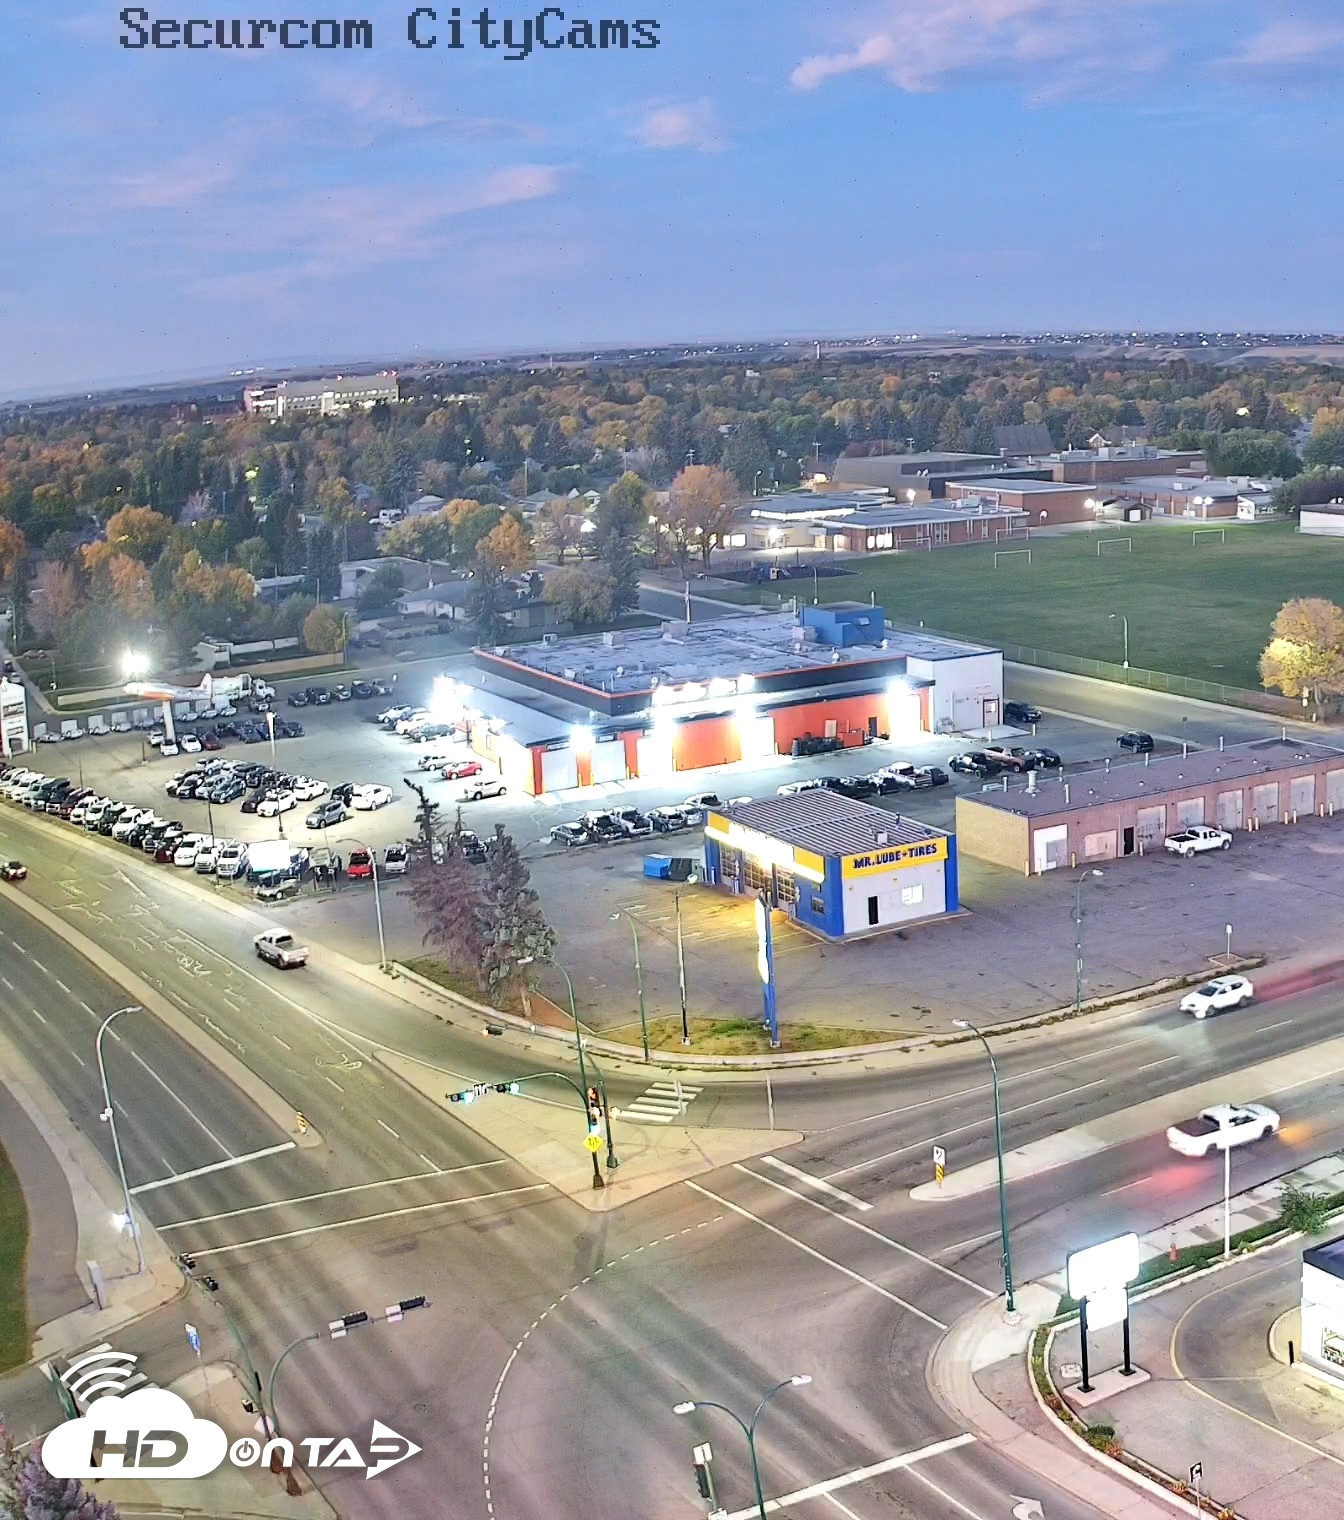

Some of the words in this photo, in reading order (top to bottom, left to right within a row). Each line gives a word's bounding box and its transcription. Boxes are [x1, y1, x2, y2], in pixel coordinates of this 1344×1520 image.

[853, 856, 875, 869] MR.
[876, 850, 901, 865] LUBE
[908, 843, 937, 859] TIRES
